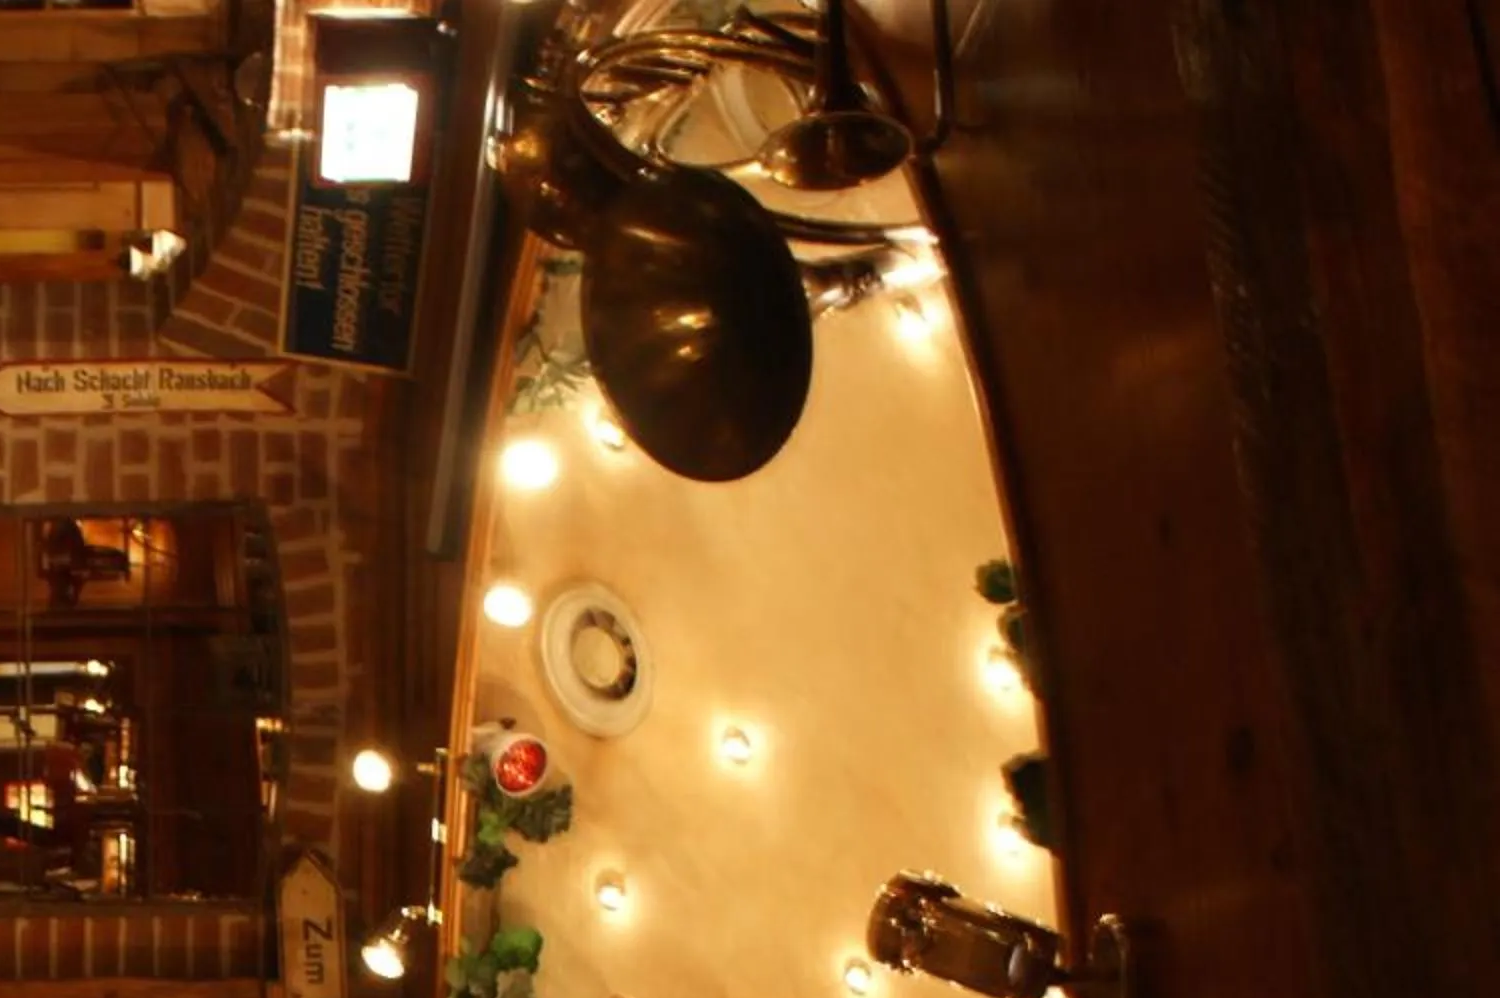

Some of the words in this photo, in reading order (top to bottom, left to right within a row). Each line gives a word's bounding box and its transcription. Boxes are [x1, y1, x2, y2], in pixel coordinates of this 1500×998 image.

[295, 204, 334, 290] halten!
[331, 207, 371, 352] geschlossen
[16, 369, 66, 394] Nach
[73, 368, 150, 393] Schacht
[158, 366, 253, 391] Ransbach
[302, 917, 335, 985] Zum
